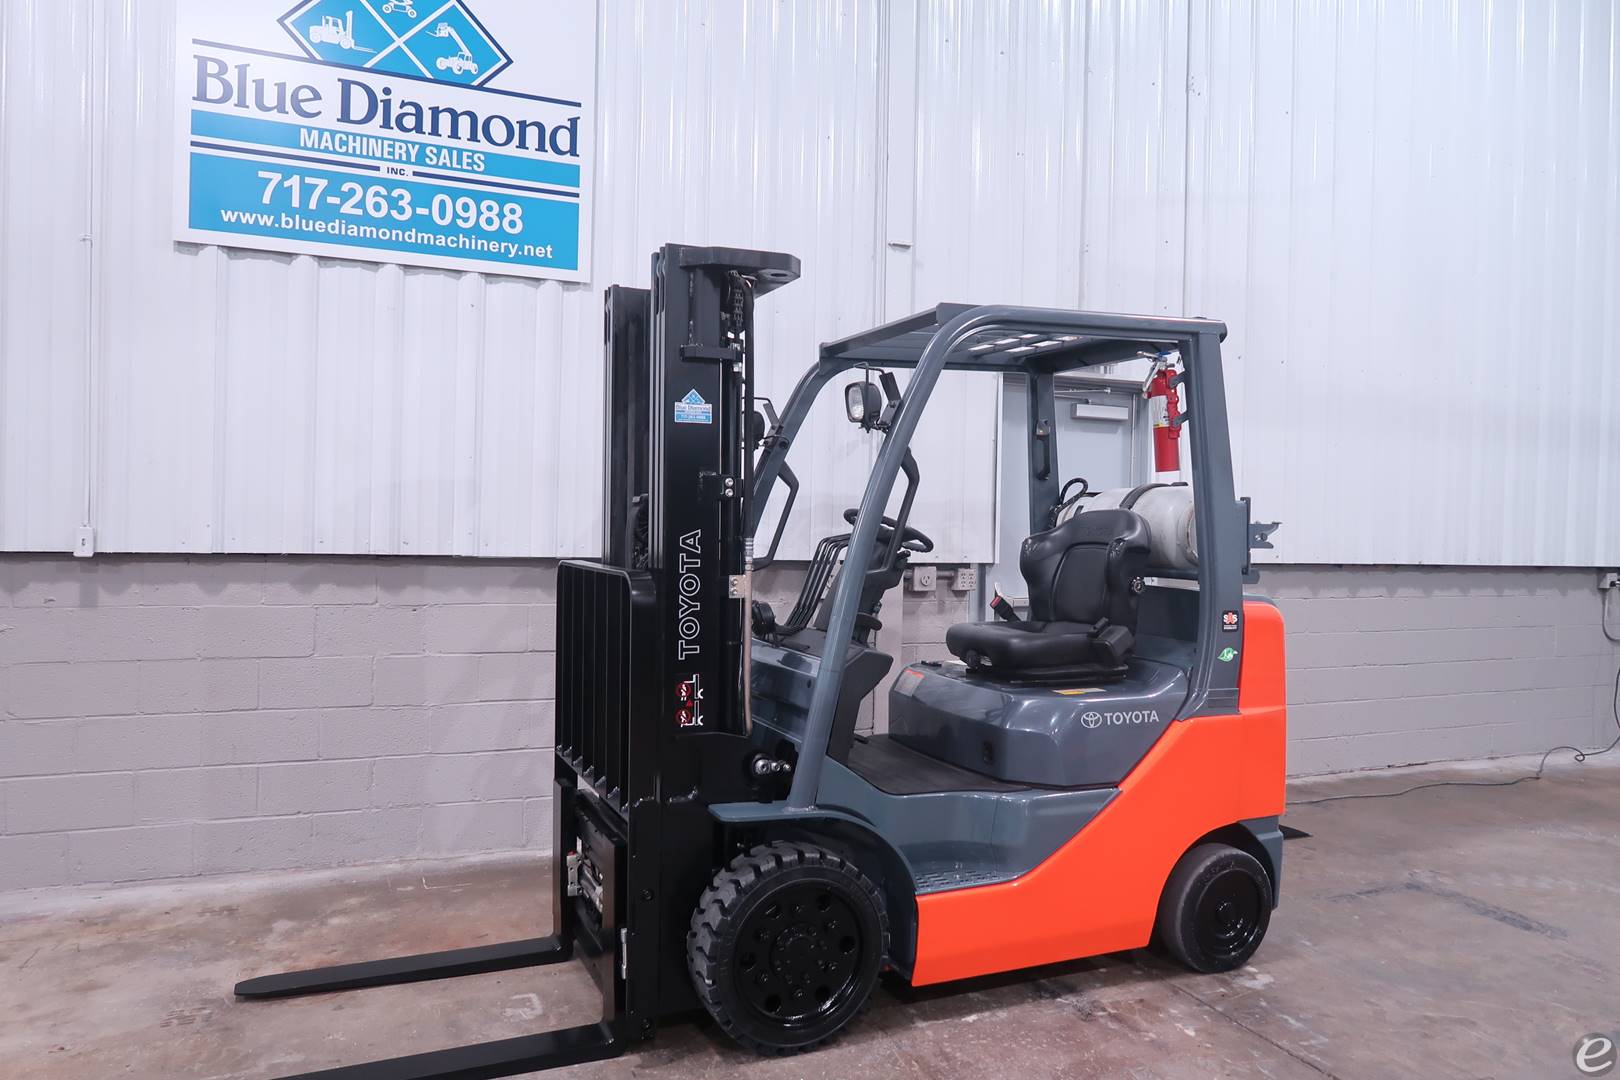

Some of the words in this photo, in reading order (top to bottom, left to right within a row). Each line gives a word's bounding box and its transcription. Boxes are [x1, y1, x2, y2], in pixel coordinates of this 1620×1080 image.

[192, 55, 322, 119] Blue
[337, 78, 580, 157] Diamond
[300, 127, 419, 163] MACHINERY
[425, 147, 485, 172] SALES
[386, 166, 409, 177] INC.
[257, 171, 524, 235] 717-263-0988
[221, 209, 553, 259] www.bluediamondmachinery.net
[678, 529, 702, 660] TOYOTA
[1104, 710, 1159, 725] TOYOTA
